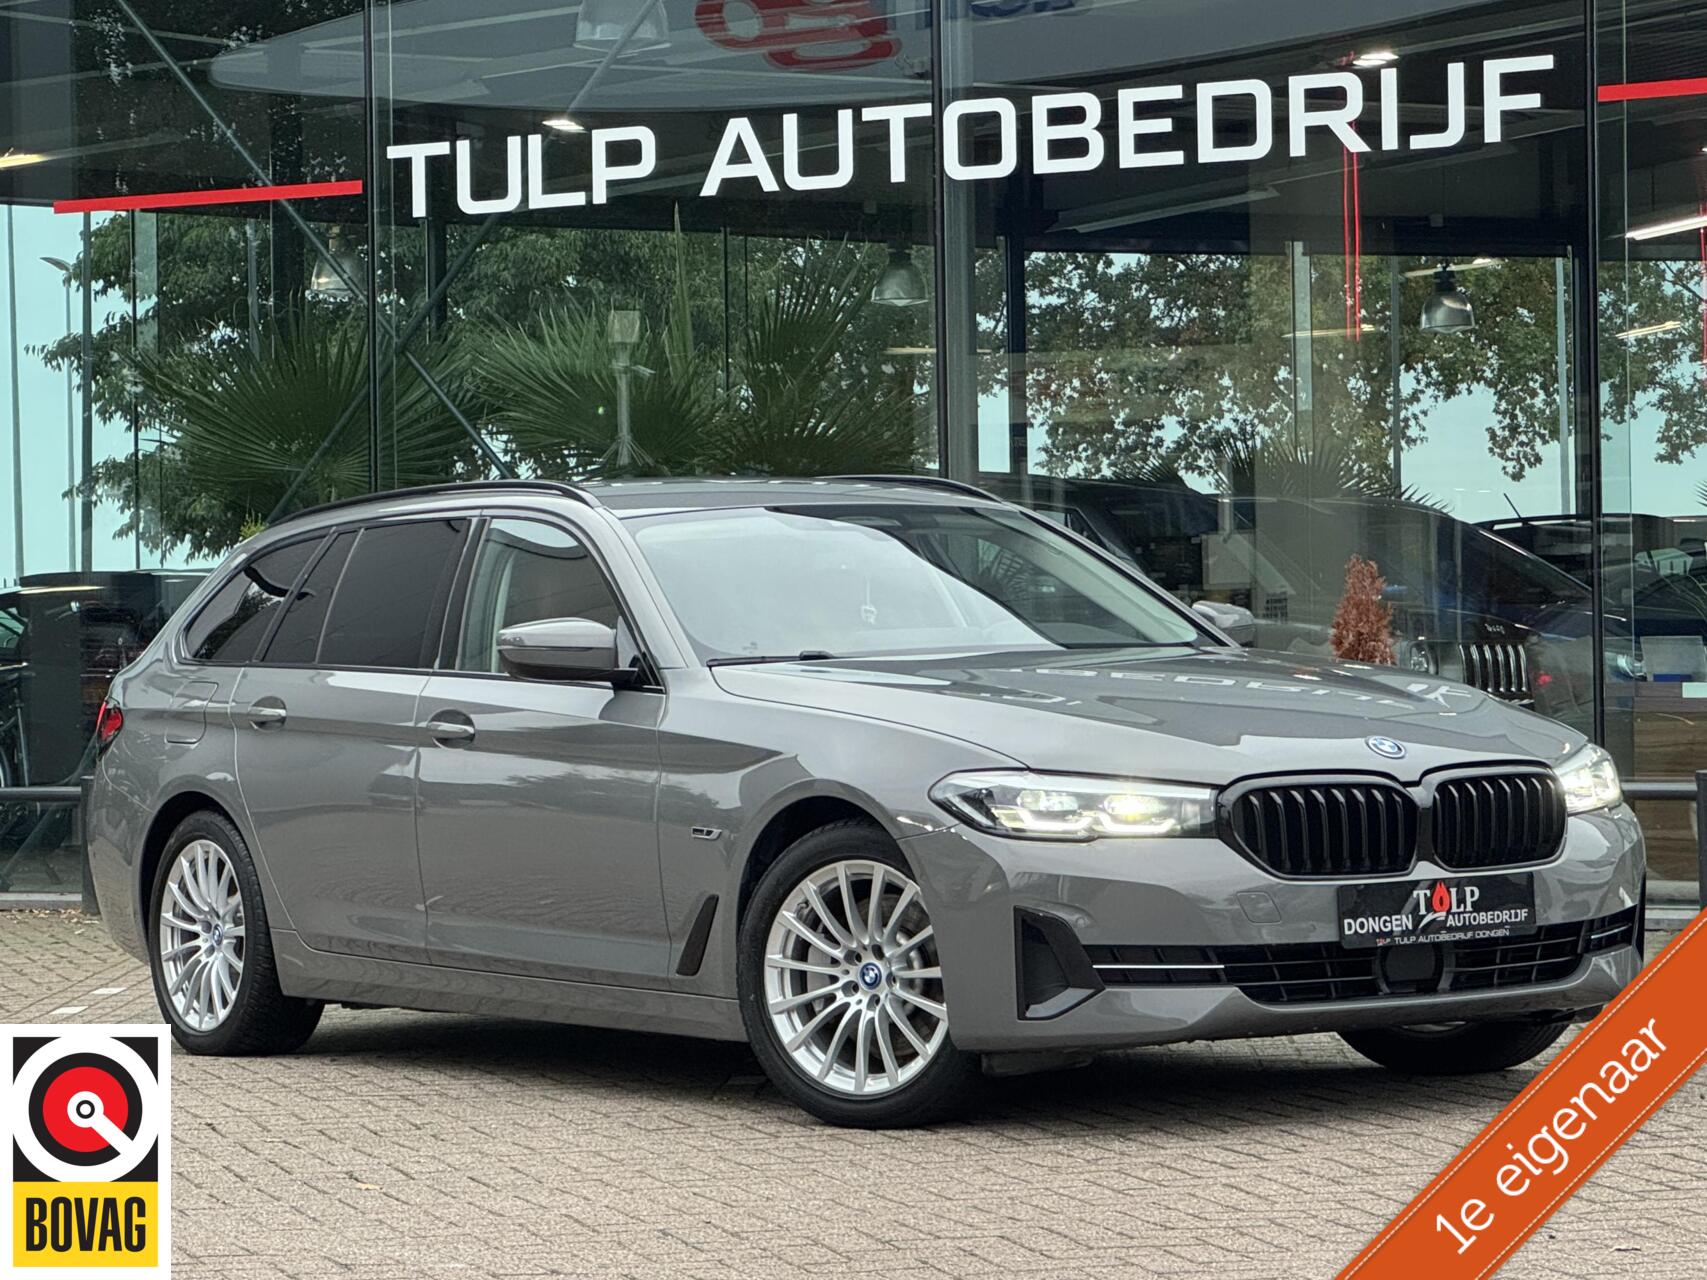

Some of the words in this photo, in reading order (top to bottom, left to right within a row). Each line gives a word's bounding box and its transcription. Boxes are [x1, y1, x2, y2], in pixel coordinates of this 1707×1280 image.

[387, 126, 656, 217] TULP
[700, 54, 1554, 197] AUTOBEDRIJF
[1344, 914, 1413, 935] DONGEN
[1446, 909, 1529, 928] AUTOBEDRIJF
[1395, 936, 1416, 945] TULP
[1418, 931, 1474, 943] AUTOBEDRIJF
[1475, 928, 1510, 939] DONGEN
